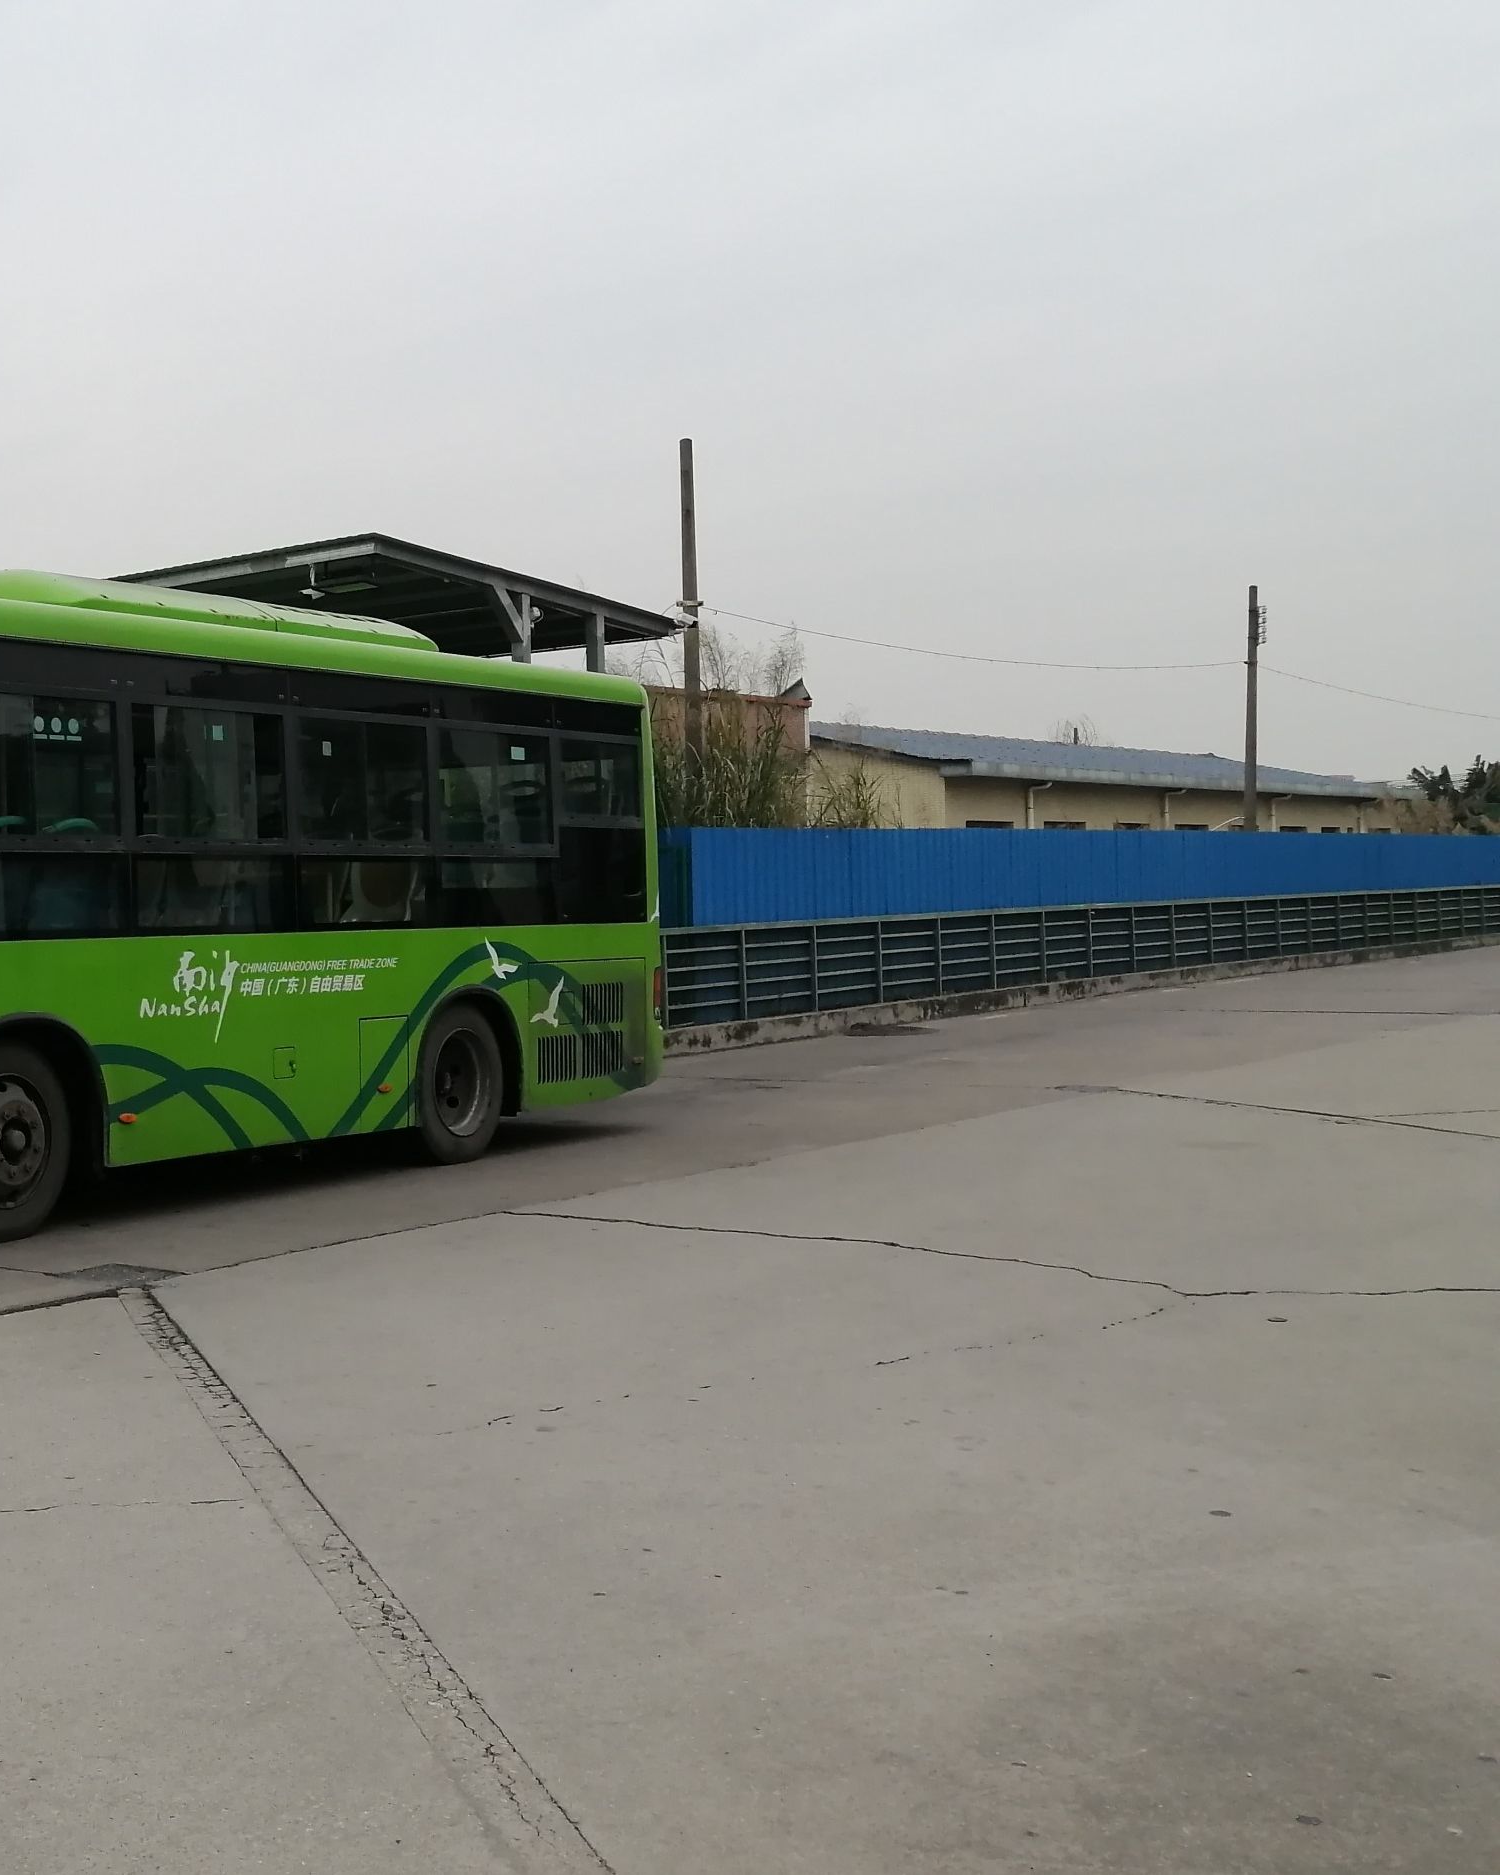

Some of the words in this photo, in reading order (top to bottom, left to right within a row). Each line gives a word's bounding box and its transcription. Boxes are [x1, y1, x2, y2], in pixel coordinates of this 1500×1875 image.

[326, 959, 347, 971] FREE
[349, 957, 375, 969] TRADE
[375, 957, 399, 968] ZONE
